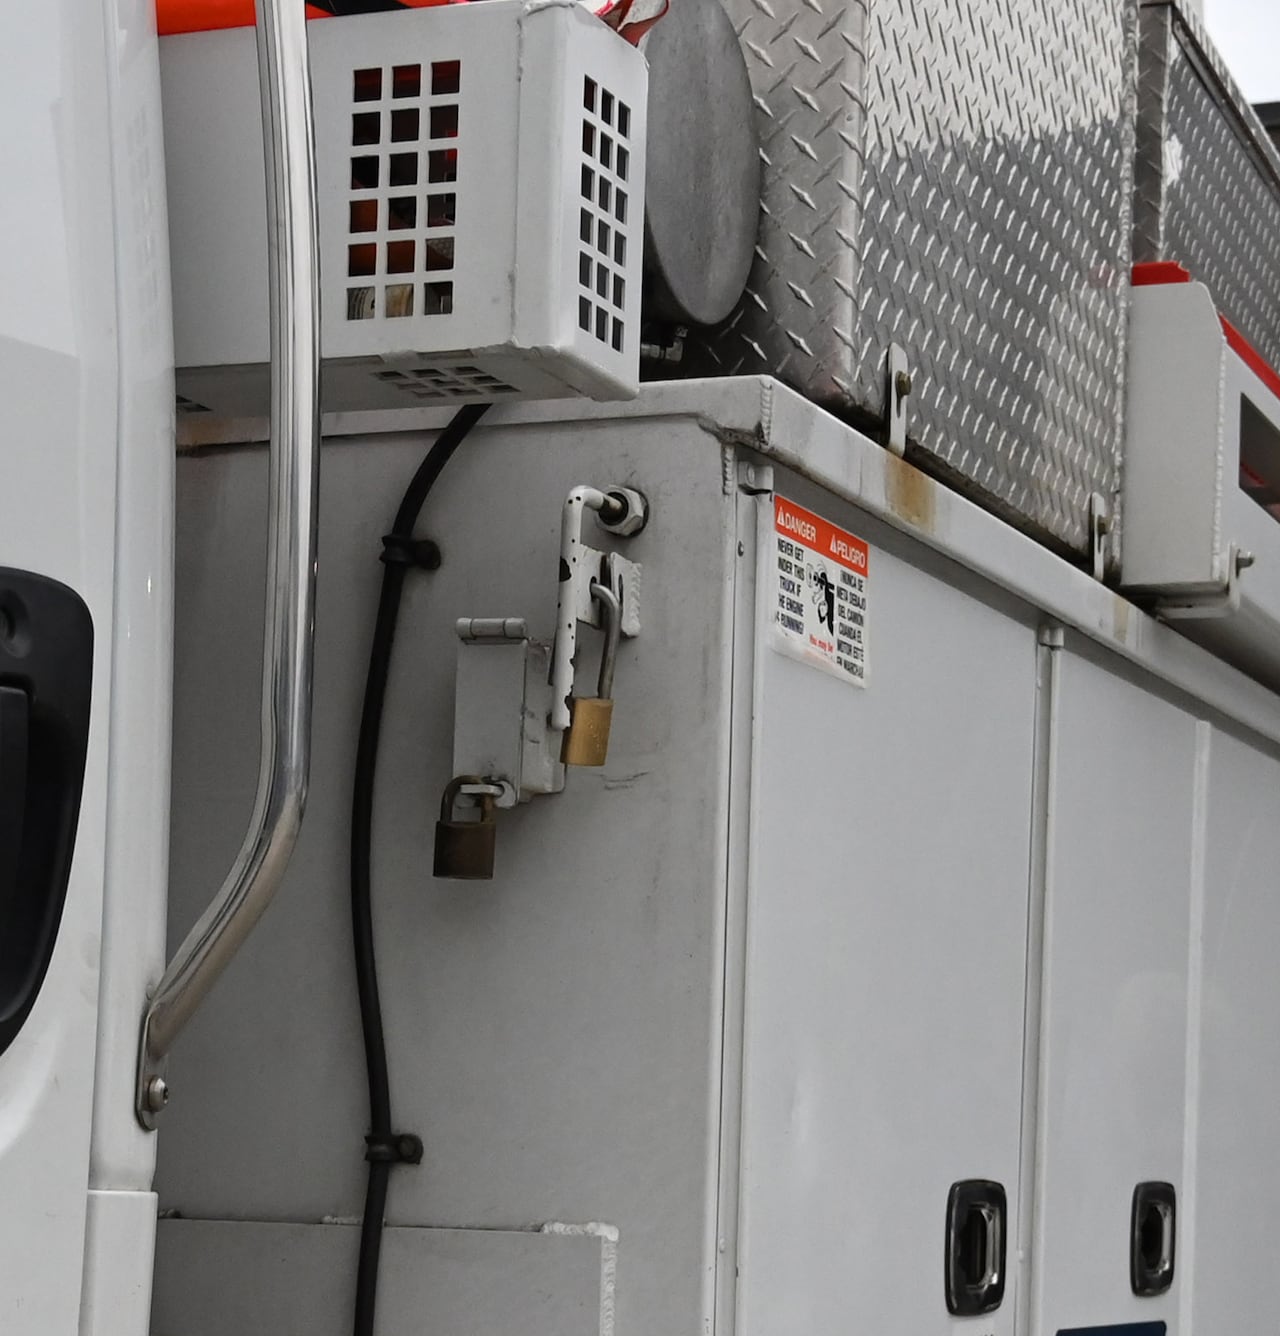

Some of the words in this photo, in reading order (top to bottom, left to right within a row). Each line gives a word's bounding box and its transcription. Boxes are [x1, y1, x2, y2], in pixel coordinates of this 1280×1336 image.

[784, 512, 817, 542] DANGER
[777, 538, 793, 557] NEVER
[794, 546, 804, 561] GET
[837, 540, 865, 568] PELIGRO
[777, 557, 792, 575] NDER
[794, 565, 805, 581] THIS
[779, 576, 796, 593] TRUCK
[787, 598, 804, 617] ENGINE
